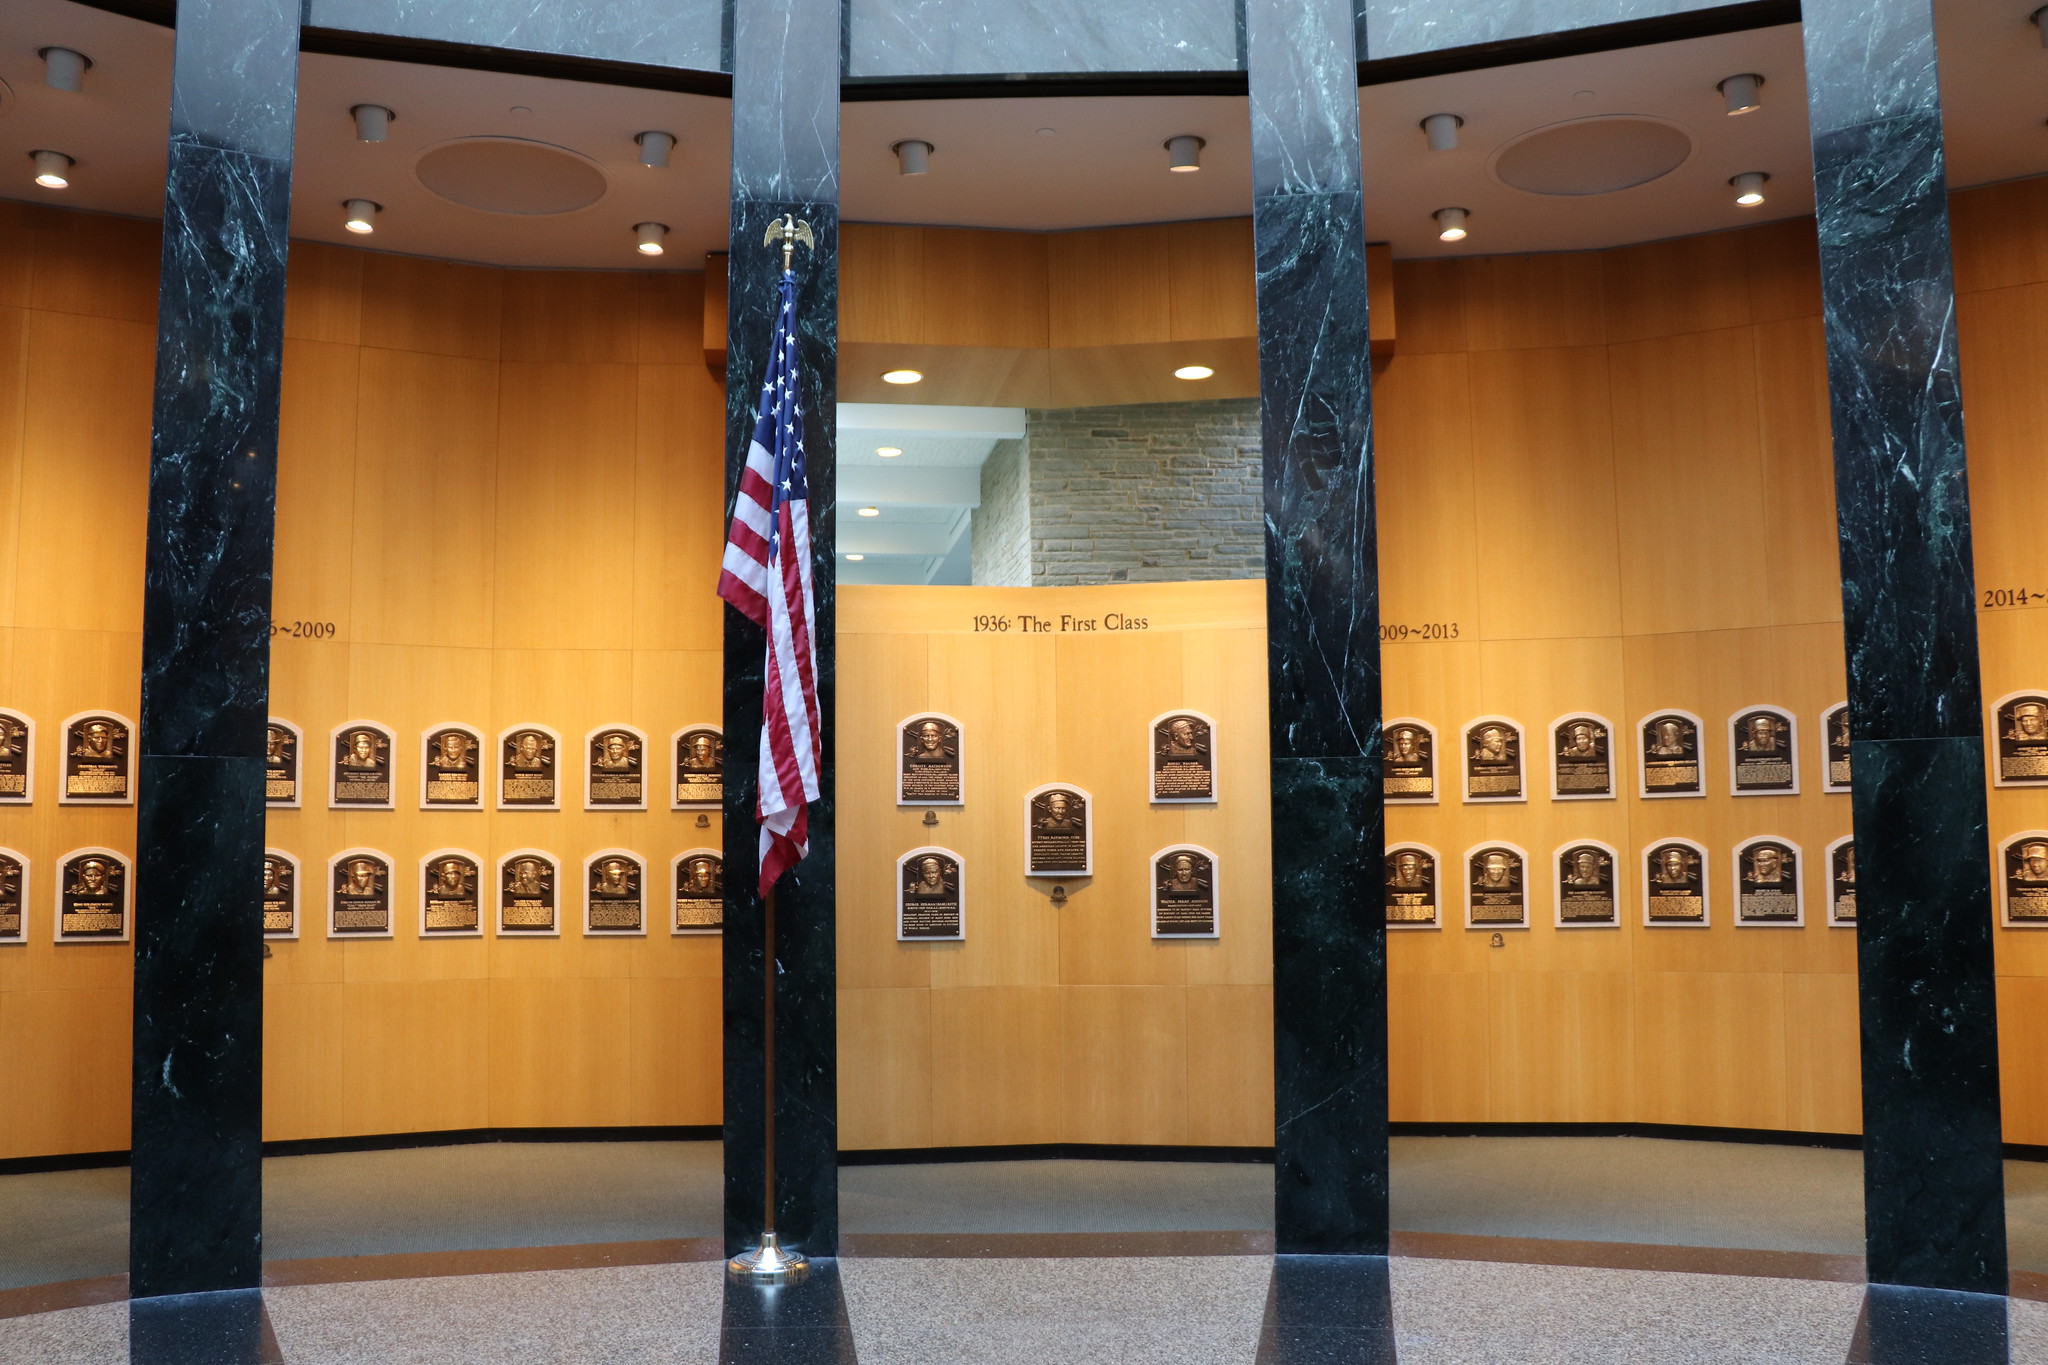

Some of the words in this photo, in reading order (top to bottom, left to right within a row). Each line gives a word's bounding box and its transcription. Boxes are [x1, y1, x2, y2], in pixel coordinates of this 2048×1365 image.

[1984, 588, 2048, 607] 2014~
[973, 615, 1011, 632] 1936:
[1017, 615, 1051, 632] The
[1060, 614, 1097, 631] First
[1104, 613, 1148, 630] Class
